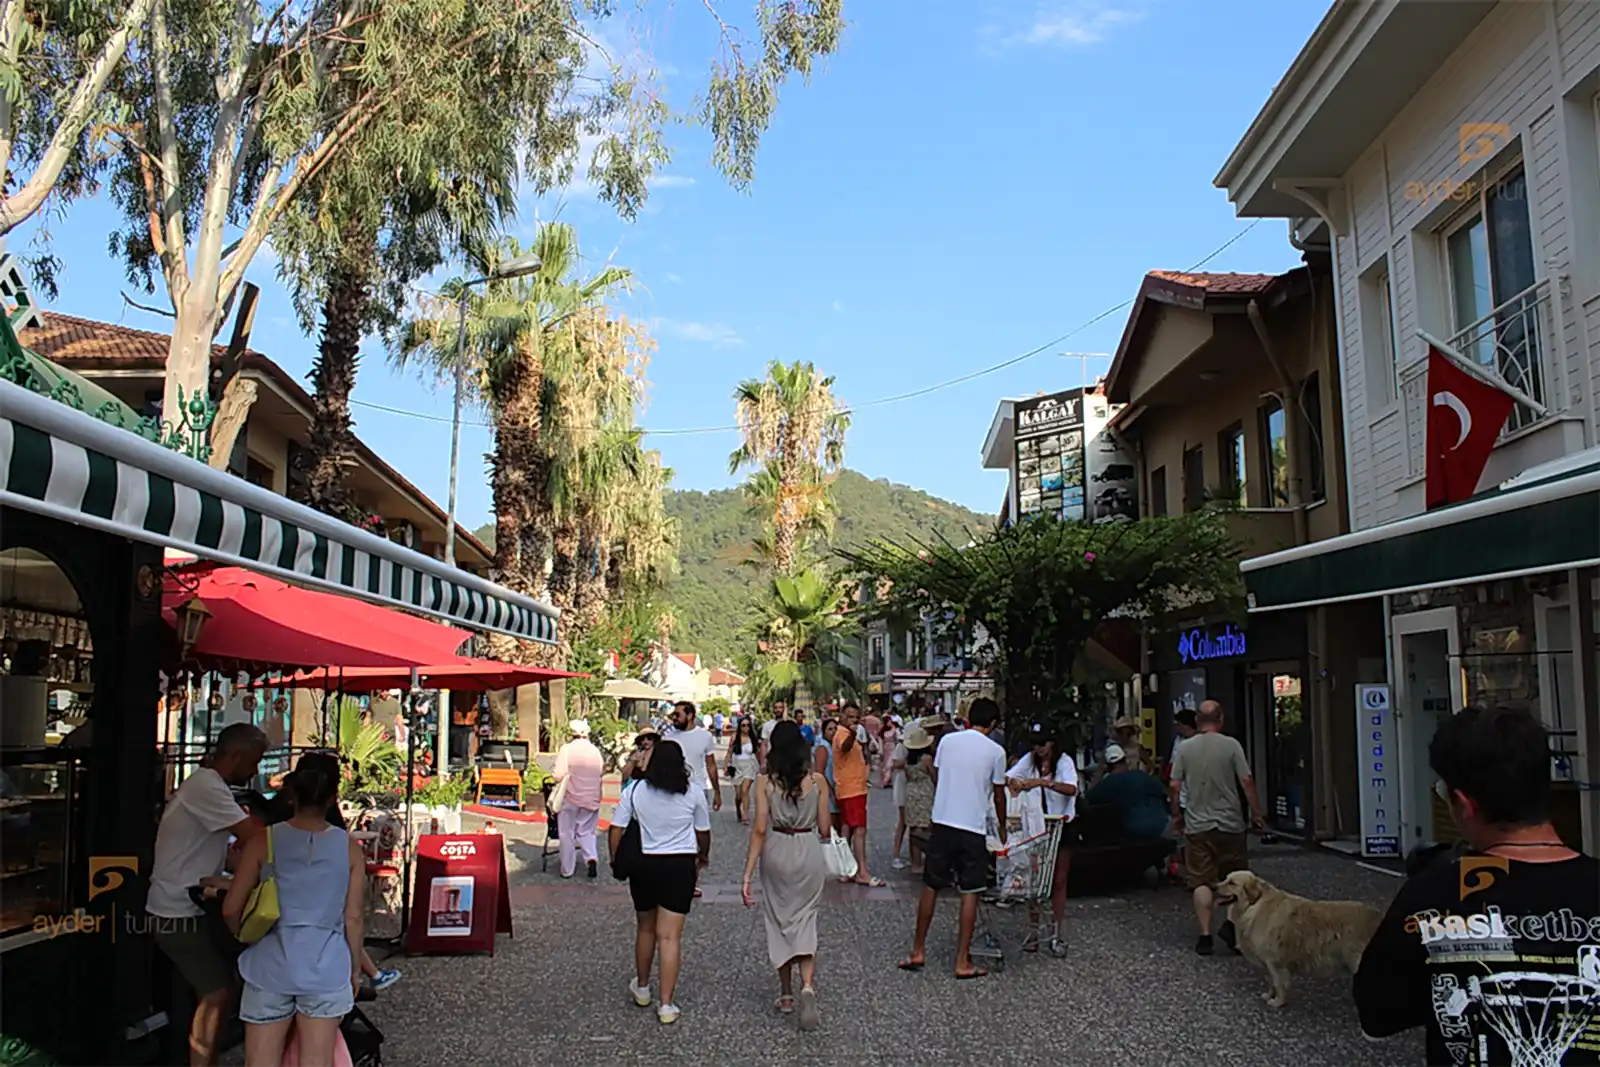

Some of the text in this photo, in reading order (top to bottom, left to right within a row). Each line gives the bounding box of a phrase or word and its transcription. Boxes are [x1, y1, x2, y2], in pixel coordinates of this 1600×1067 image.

[1189, 624, 1246, 660] Columbia
[1371, 712, 1388, 835] dedeminn
[439, 845, 477, 856] COSTA
